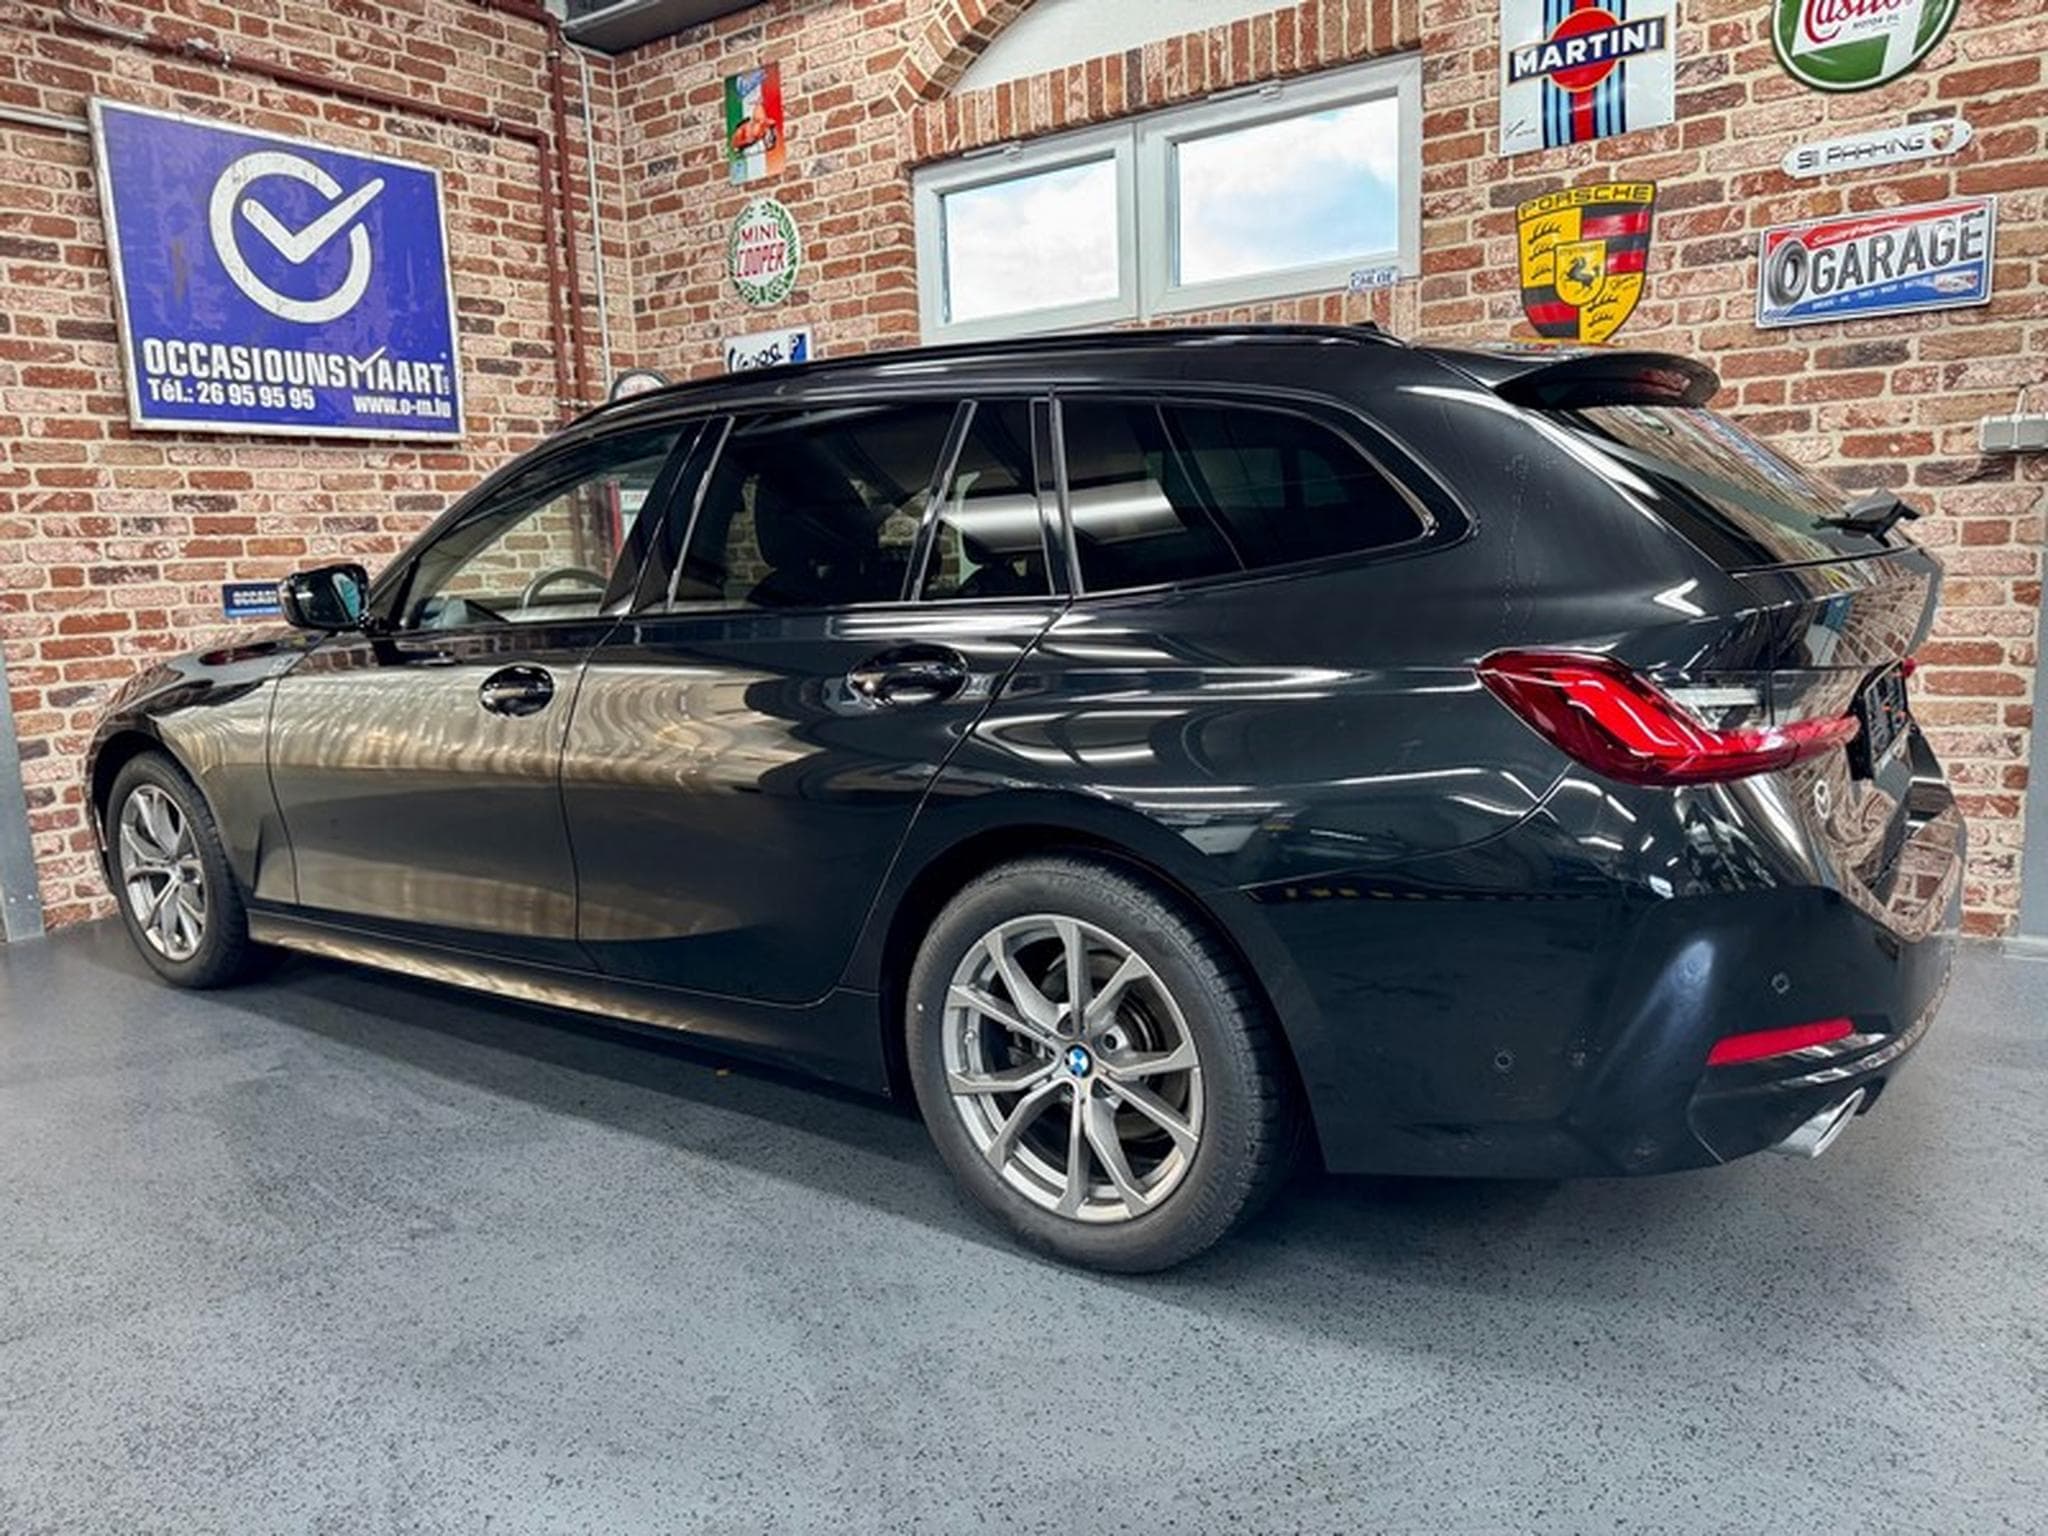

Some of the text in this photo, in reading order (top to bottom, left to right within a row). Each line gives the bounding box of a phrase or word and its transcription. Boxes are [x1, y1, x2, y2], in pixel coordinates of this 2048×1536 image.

[1514, 22, 1658, 78] MARTINI
[1826, 132, 1924, 164] PARKING
[1520, 186, 1650, 218] PORSCHE
[741, 222, 777, 242] MINI
[737, 242, 785, 278] COOPER
[1810, 209, 1985, 296] GARAGE
[143, 338, 444, 395] OCCASIOUNSMAART
[147, 378, 451, 418] Tél.: 26 95 95 95 www.o-m.lu
